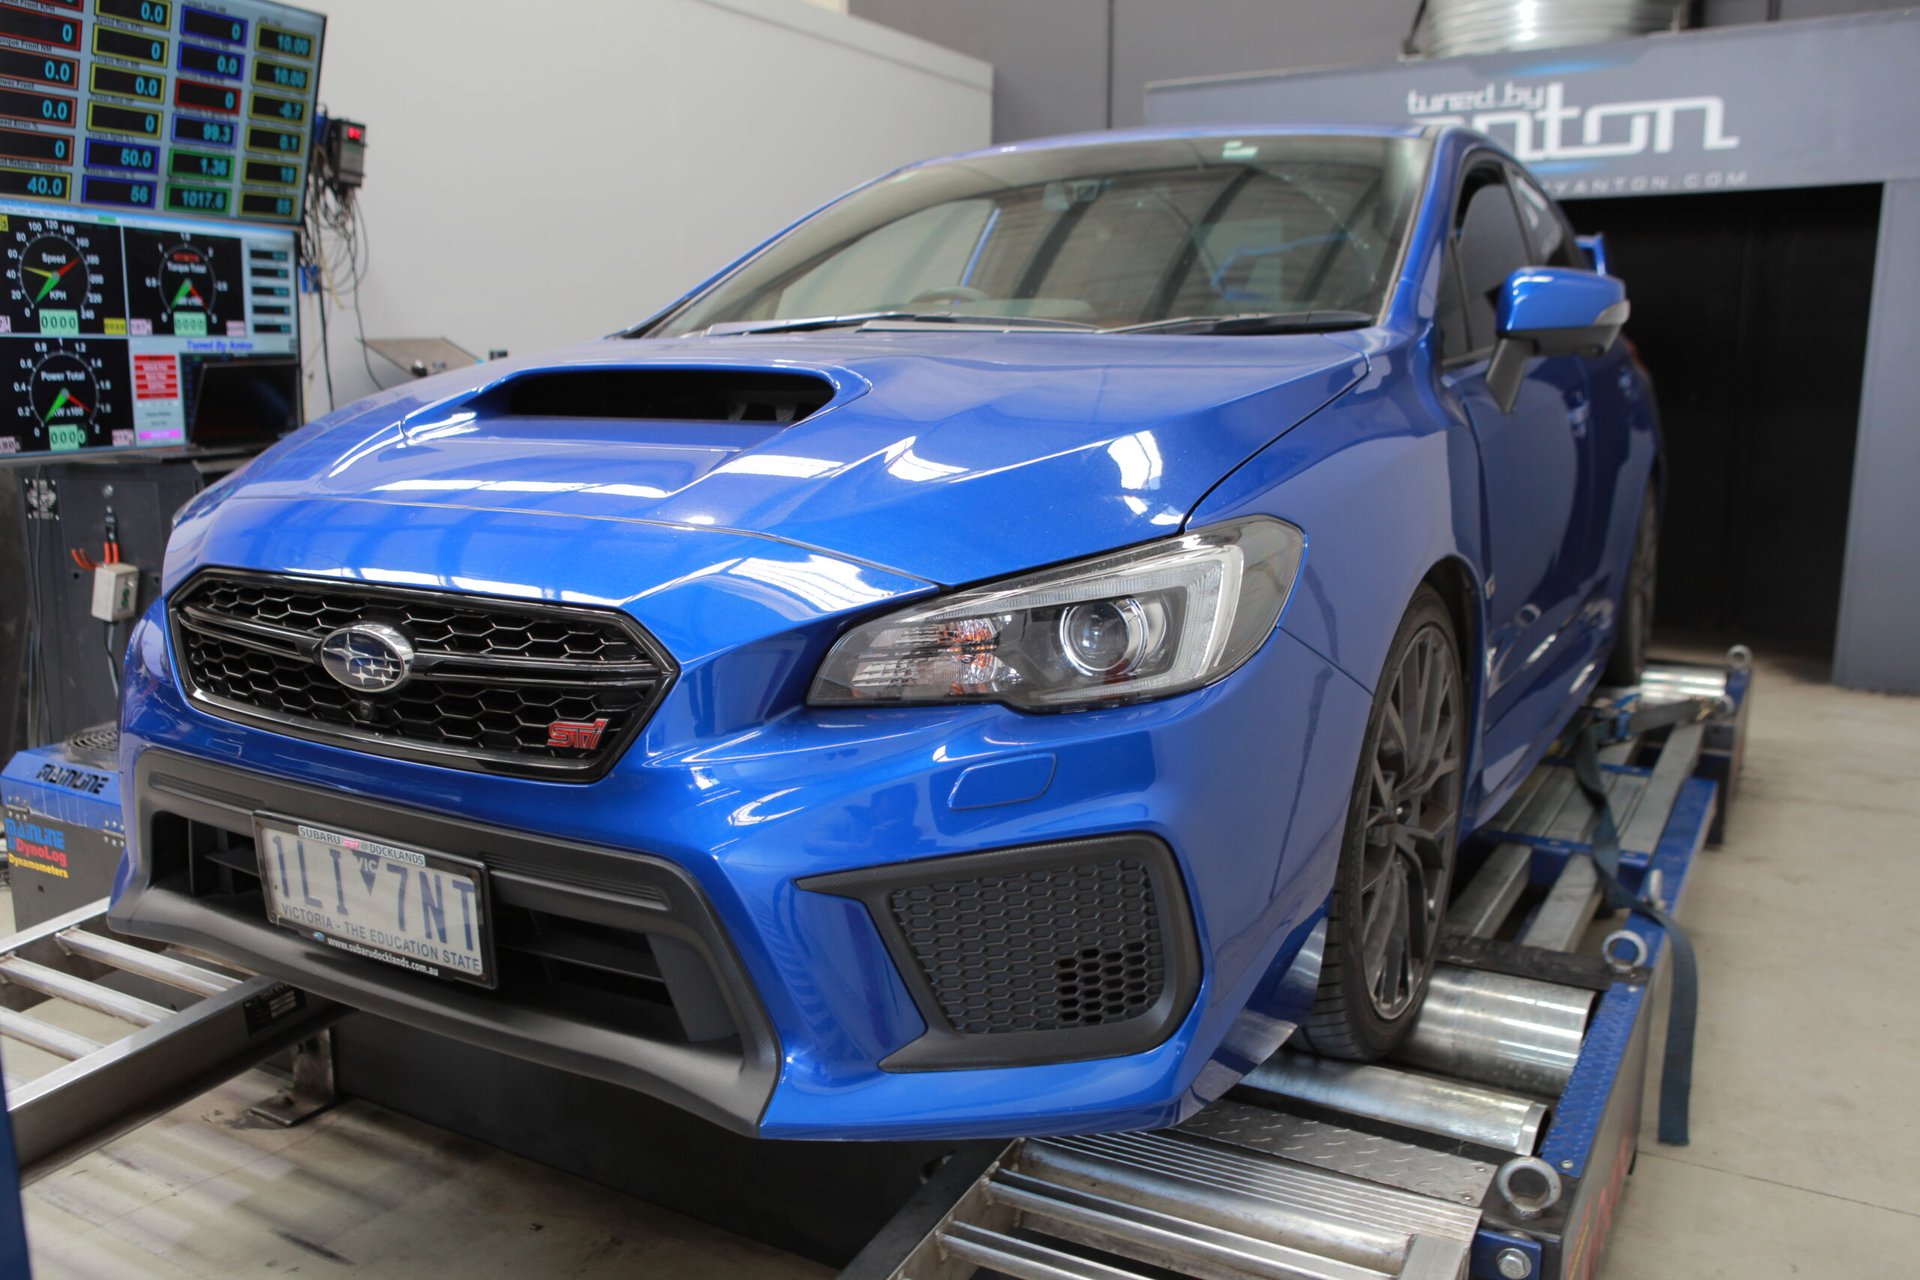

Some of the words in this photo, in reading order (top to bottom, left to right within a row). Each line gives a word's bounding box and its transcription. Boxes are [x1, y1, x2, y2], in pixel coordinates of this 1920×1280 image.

[141, 2, 163, 23] 0.0
[63, 23, 72, 42] 0
[232, 23, 241, 40] 0
[151, 42, 161, 59] 0
[45, 60, 70, 81] 0.0
[217, 54, 238, 75] 0.0
[135, 76, 158, 96] 0.0
[225, 91, 235, 109] 0
[1407, 82, 1495, 115] tuned
[1504, 80, 1544, 111] by
[43, 99, 67, 120] 0.0
[145, 114, 155, 132] 0
[55, 139, 65, 158] 0
[27, 176, 62, 196] 40.0
[1543, 170, 1748, 196] YANTON.COM
[28, 221, 42, 232] 100
[45, 219, 58, 230] 120
[61, 225, 75, 235] 140
[16, 232, 26, 242] 80
[7, 249, 18, 259] 60
[42, 252, 66, 264] Speed
[6, 269, 16, 279] 40
[11, 290, 21, 300] 20
[49, 290, 67, 300] KPH
[24, 307, 30, 317] 0
[41, 316, 76, 329] 0000
[40, 371, 65, 382] Power
[65, 370, 86, 381] Total
[13, 382, 26, 392] 0.4
[17, 406, 30, 417] 0.2
[34, 427, 40, 437] 0
[15, 837, 68, 868] DynoLog
[299, 827, 341, 845] SUBARU
[369, 843, 424, 866] DOCKLANDS
[8, 852, 69, 879] Dynamometers
[357, 857, 378, 874] VIC
[281, 902, 333, 930] VICTORIA
[344, 922, 366, 939] THE
[370, 929, 439, 960] EDUCATION
[442, 950, 480, 972] STATE
[327, 937, 439, 977] www.subarudocklands.com.au
